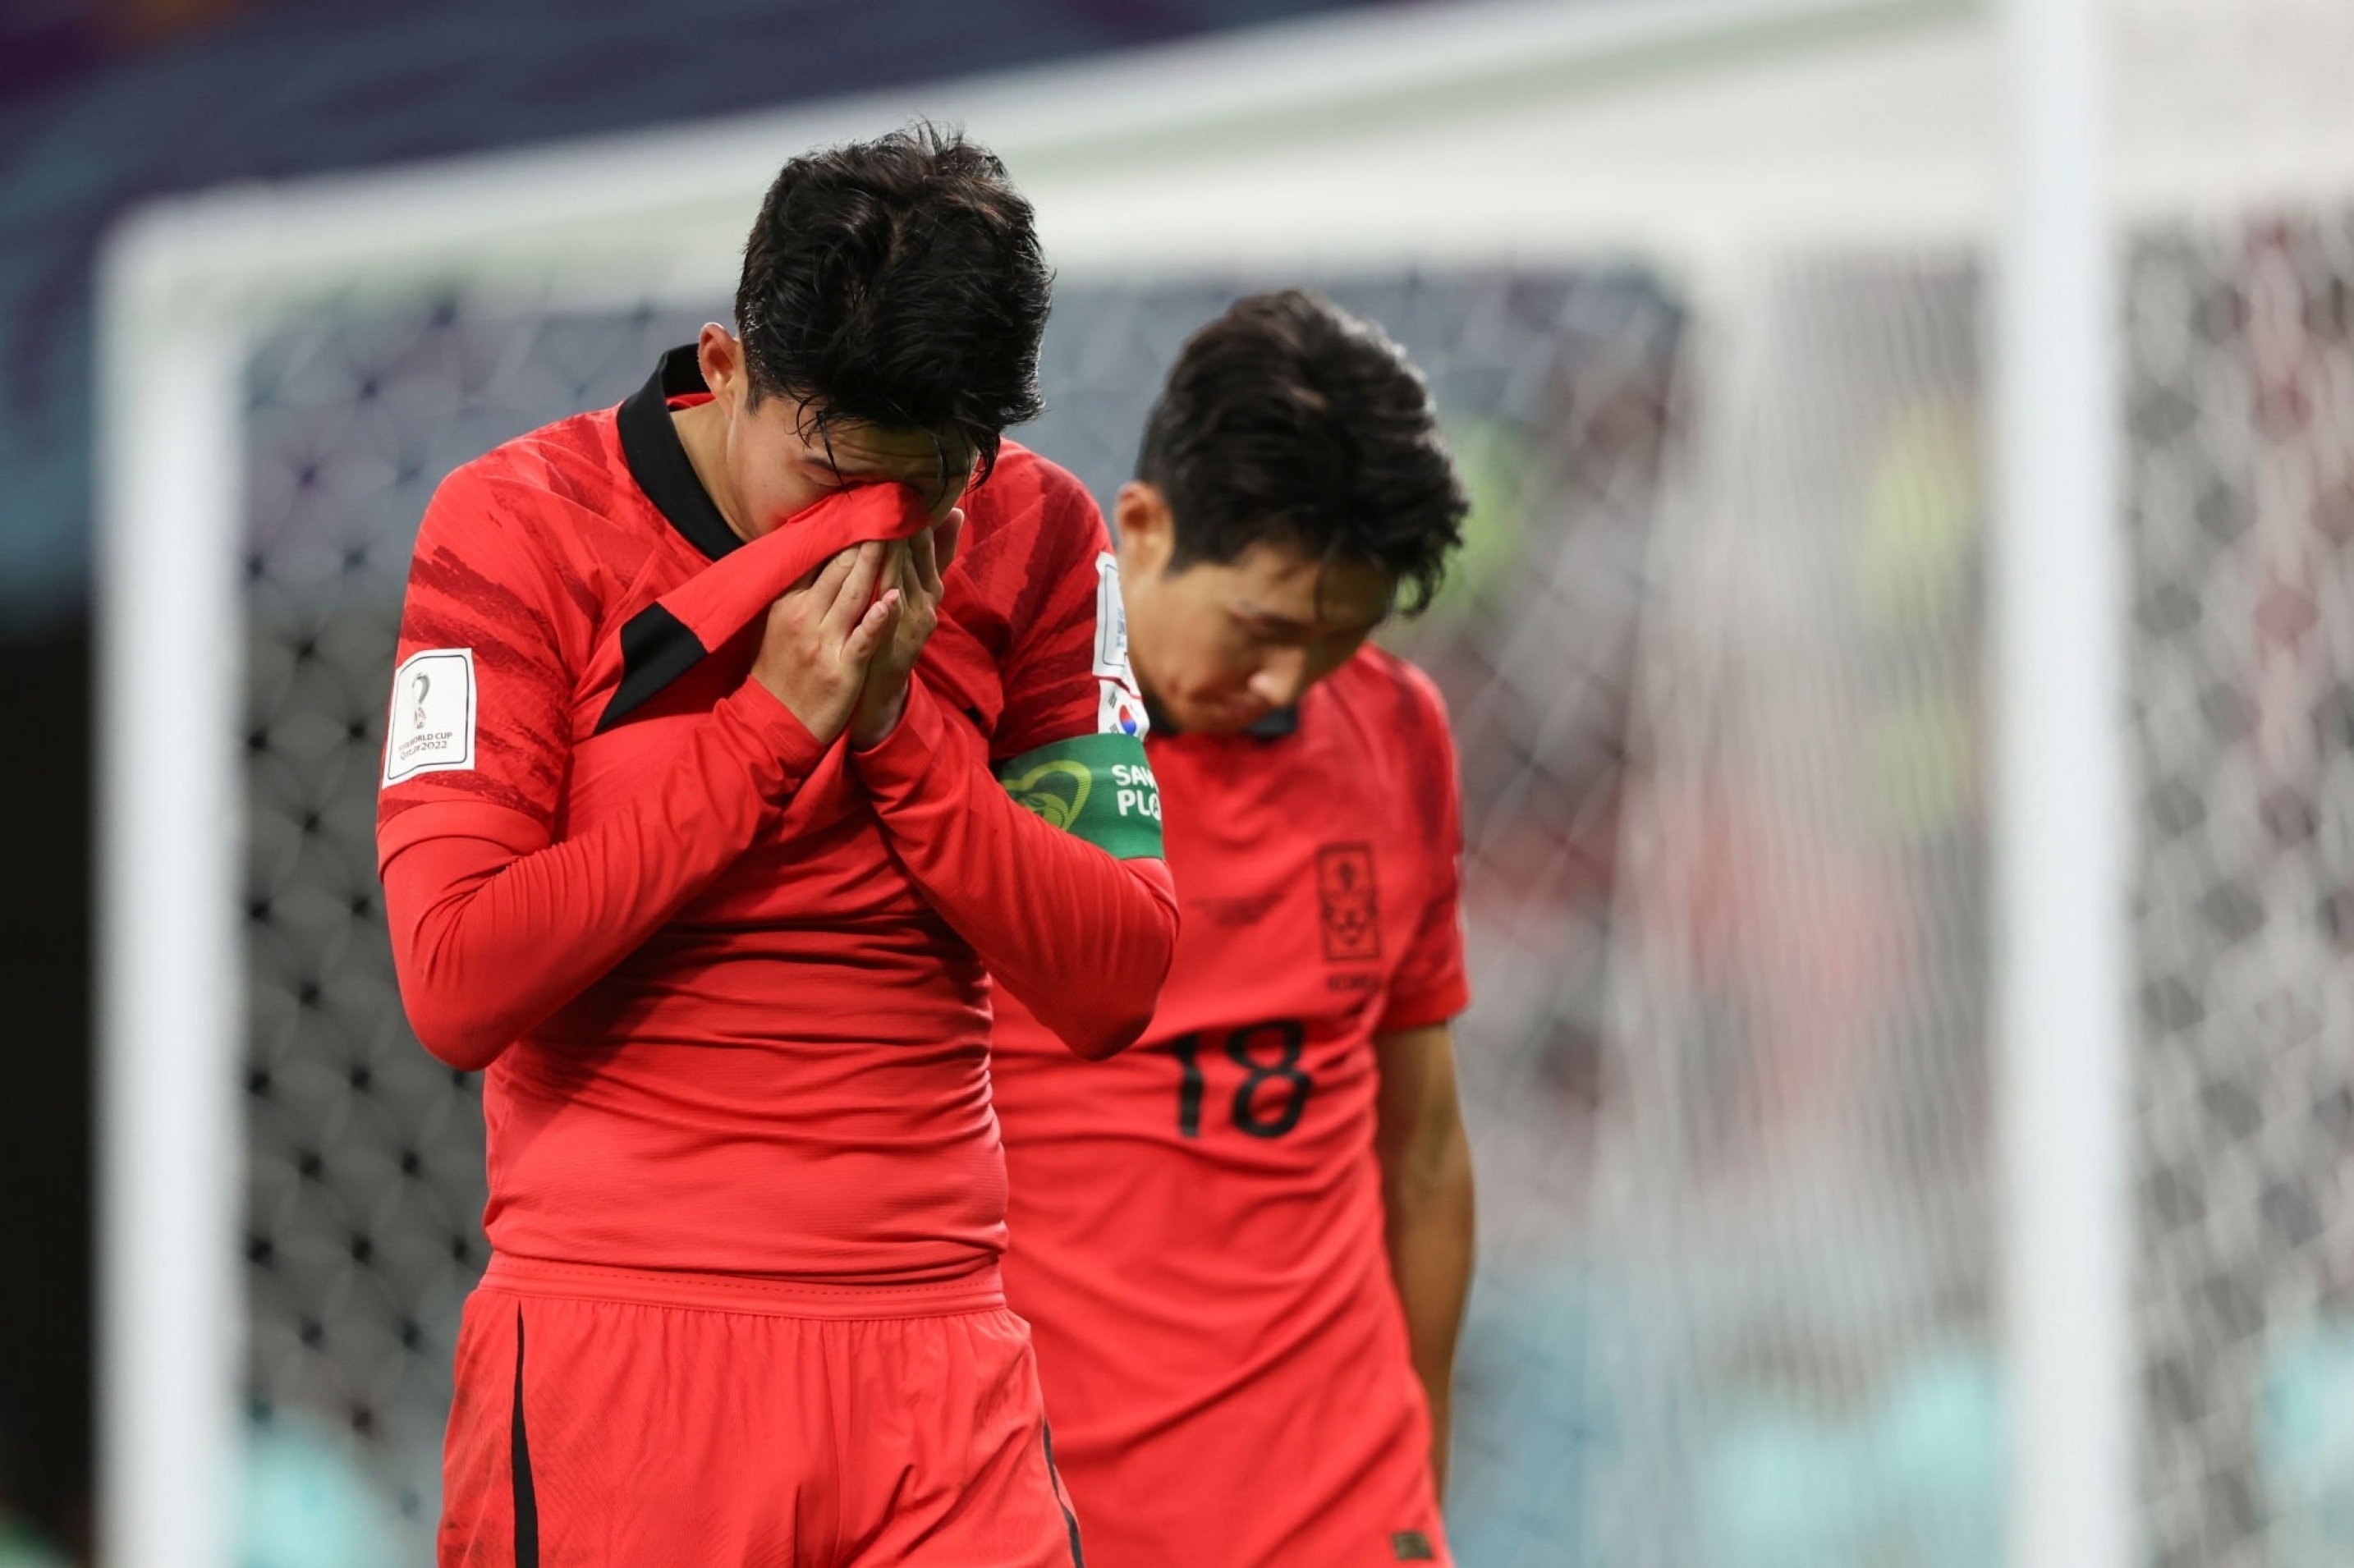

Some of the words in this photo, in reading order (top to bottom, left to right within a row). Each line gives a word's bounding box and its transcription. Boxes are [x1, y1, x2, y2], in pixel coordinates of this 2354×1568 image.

[421, 740, 447, 750] 2022
[435, 731, 452, 740] CUP
[1112, 764, 1159, 795] SAV
[1169, 1020, 1312, 1139] 18
